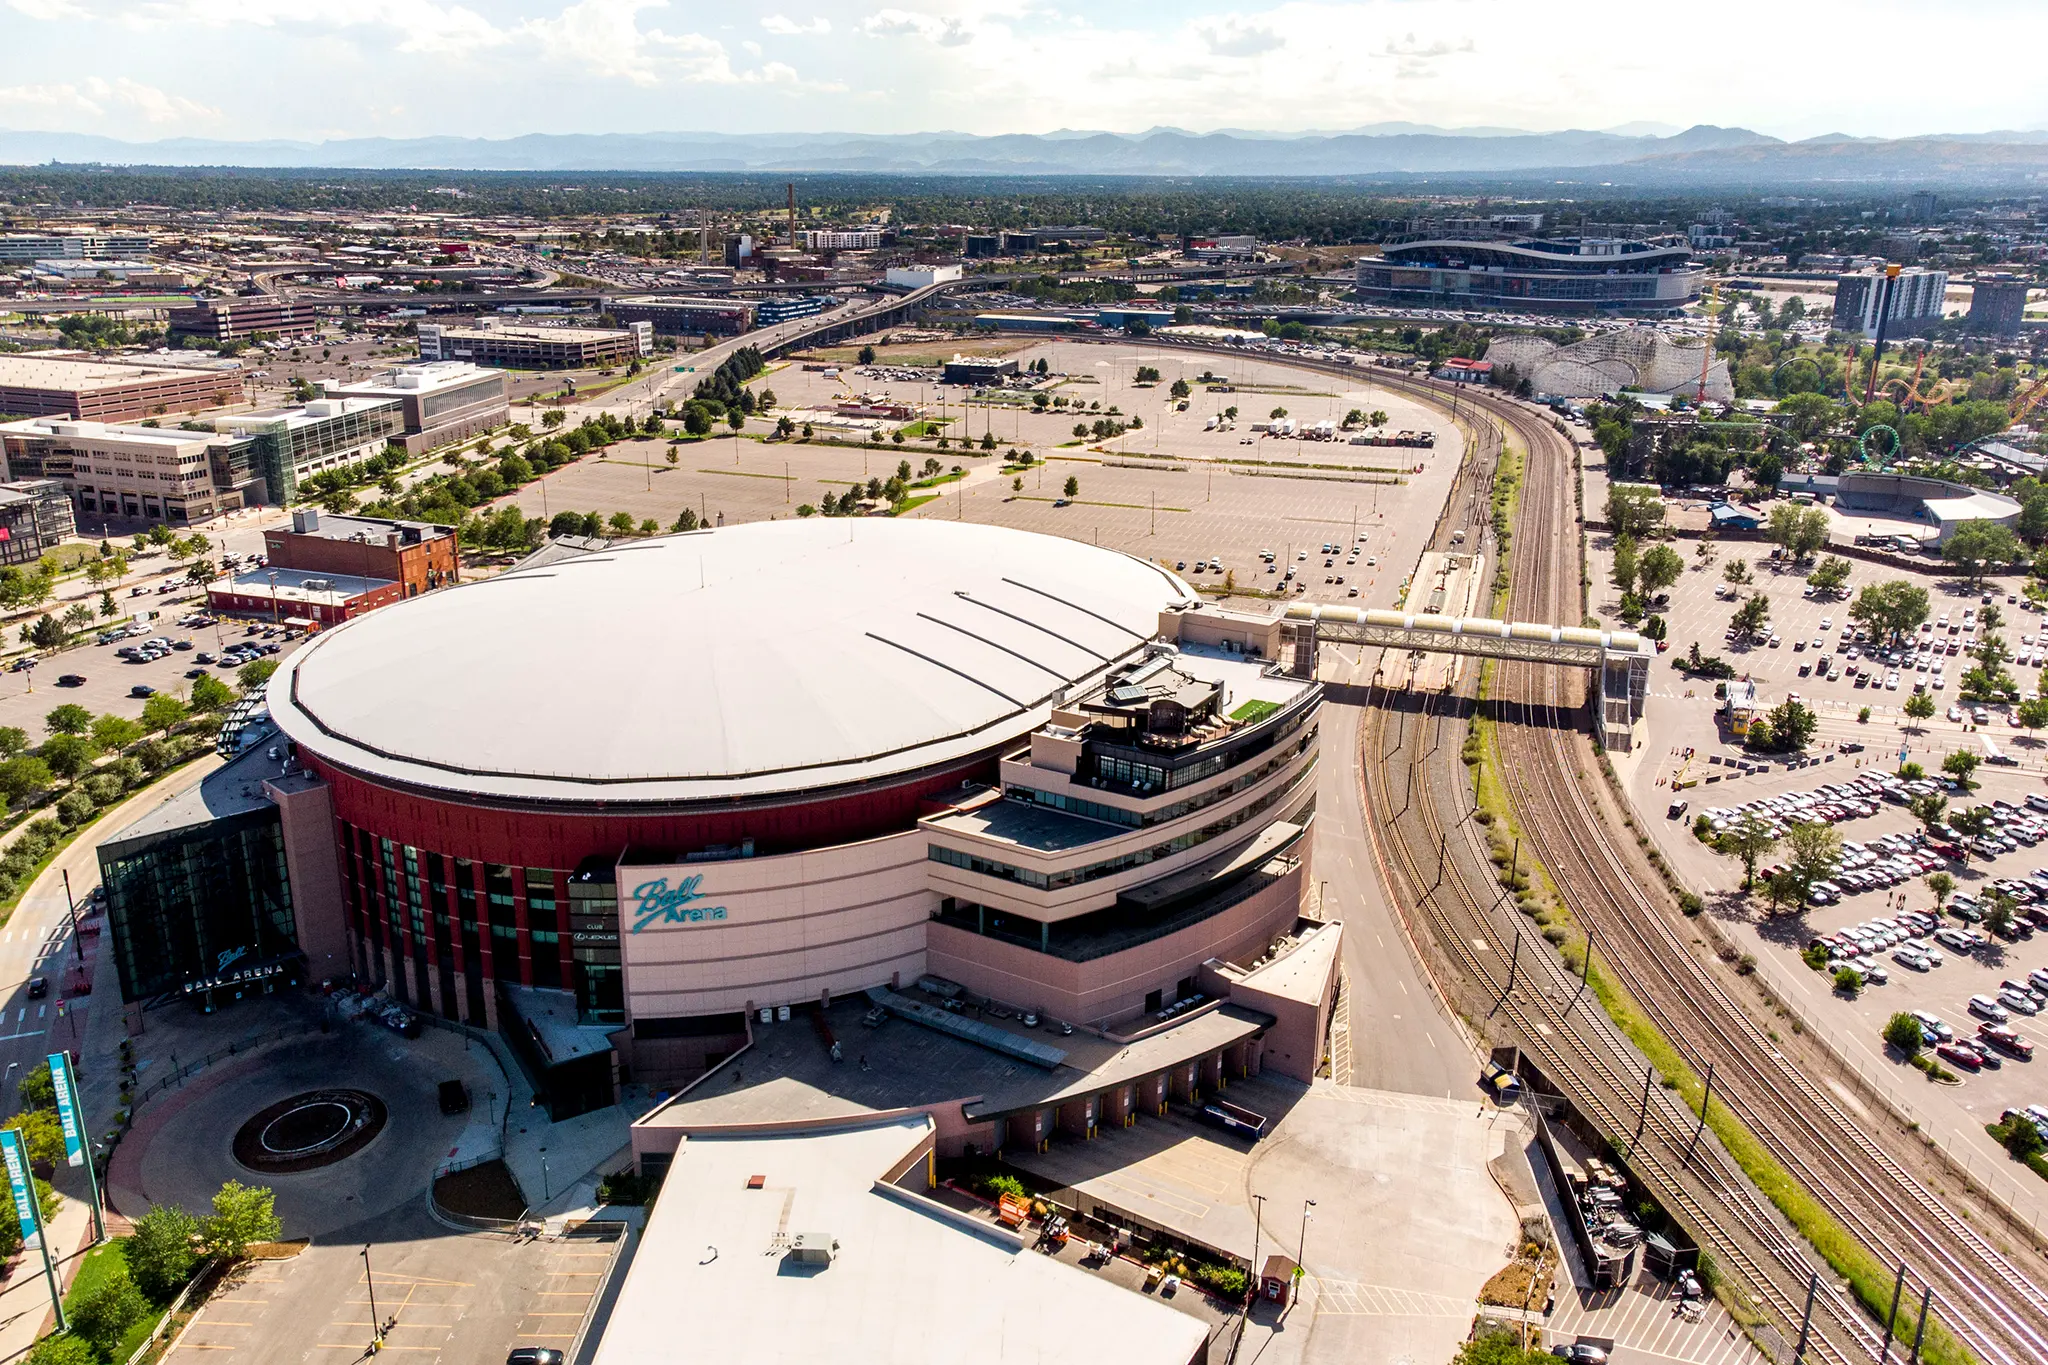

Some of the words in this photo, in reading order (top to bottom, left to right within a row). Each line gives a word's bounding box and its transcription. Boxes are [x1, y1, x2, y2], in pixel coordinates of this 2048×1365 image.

[633, 874, 705, 935] Ball
[664, 904, 728, 924] Arena
[185, 977, 222, 992] BALL
[233, 965, 283, 980] ARENA
[52, 1066, 70, 1106] ARENA
[61, 1108, 77, 1138] BALL
[4, 1144, 24, 1185] ARENA
[14, 1188, 32, 1220] BALL
